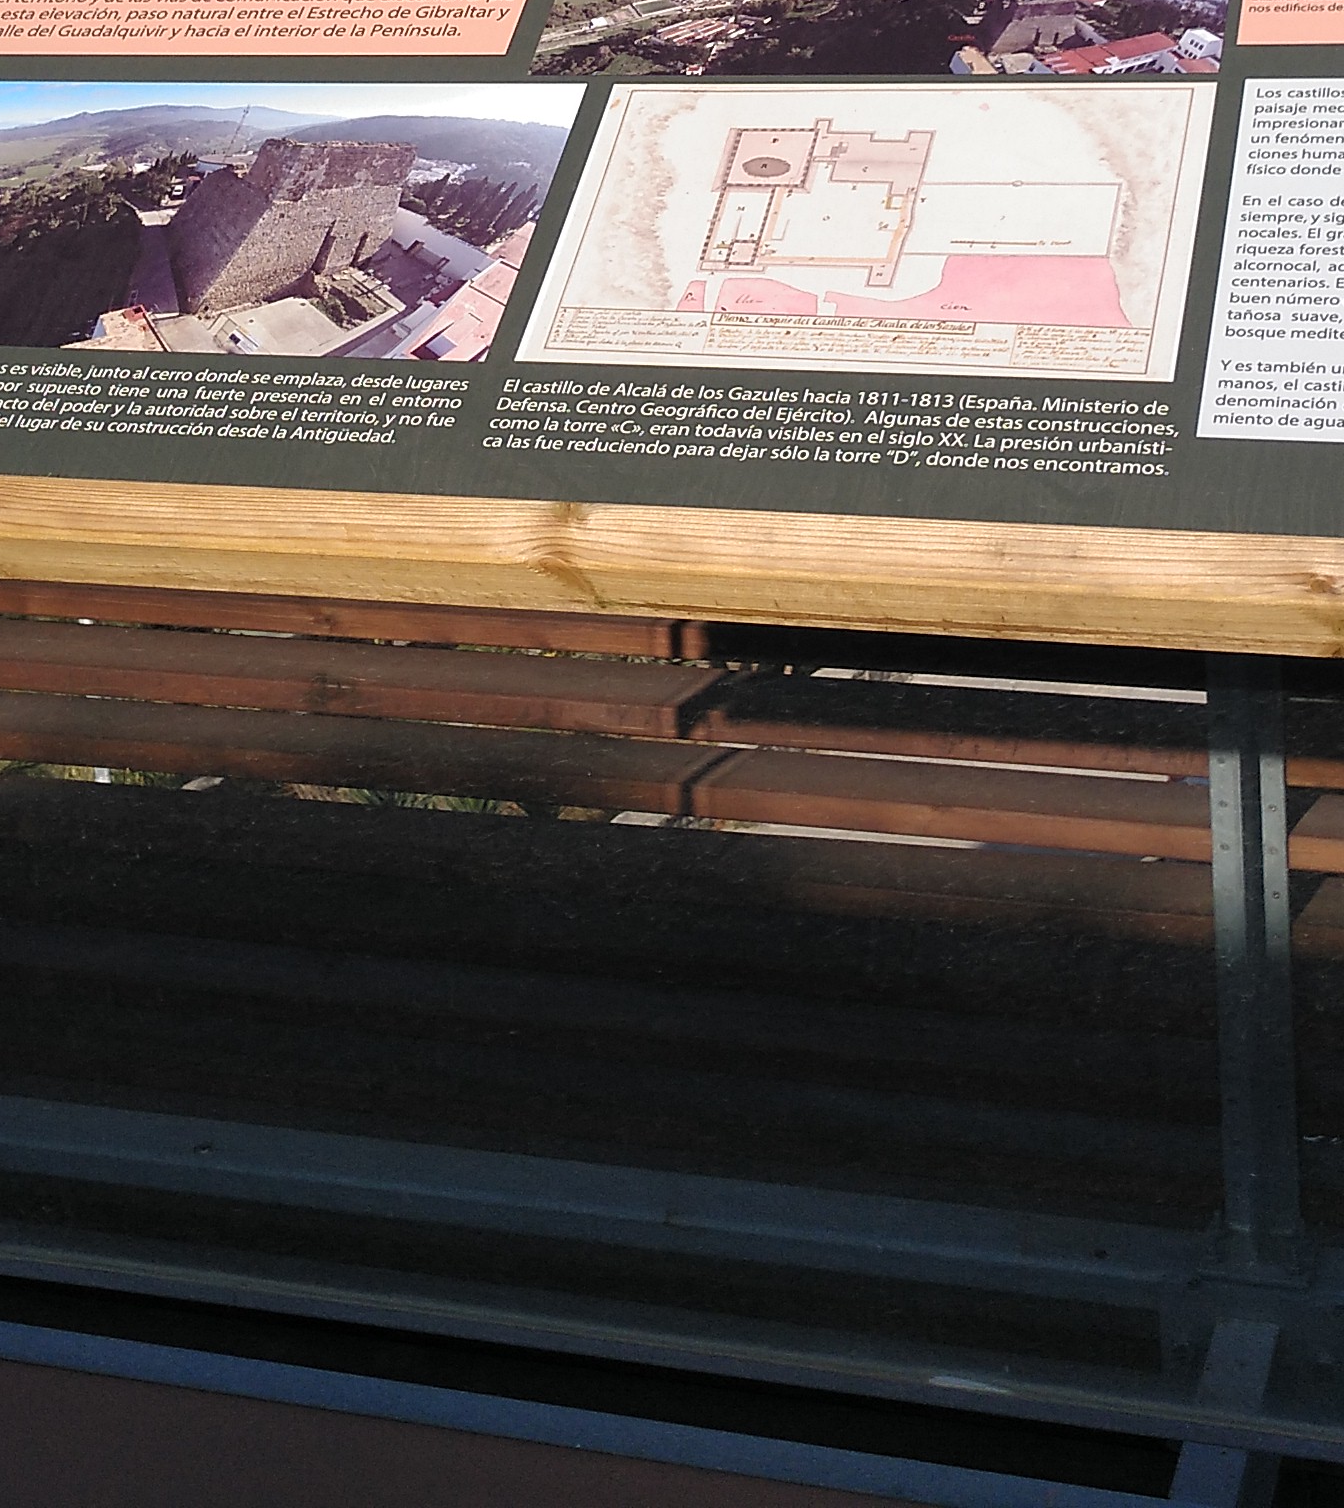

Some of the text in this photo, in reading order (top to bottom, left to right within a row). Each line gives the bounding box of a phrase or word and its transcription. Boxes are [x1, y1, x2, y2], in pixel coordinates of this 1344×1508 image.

[1248, 5, 1271, 13] nos
[1273, 3, 1325, 12] edificios
[27, 24, 57, 37] del
[58, 24, 168, 40] Guadalquivir
[168, 27, 182, 41] y
[184, 24, 230, 37] hacia
[234, 24, 253, 37] el
[253, 24, 321, 37] interior
[323, 24, 346, 37] de
[350, 23, 366, 37] la
[370, 23, 461, 37] Península.
[1256, 88, 1282, 98] Los
[1227, 309, 1281, 321] tañosa
[1291, 312, 1343, 324] suave,
[1225, 325, 1286, 340] bosque
[1213, 412, 1273, 425] miento
[1277, 414, 1299, 426] de
[14, 414, 59, 432] lugar
[60, 416, 82, 430] de
[83, 420, 105, 431] su
[107, 421, 214, 436] construcción
[217, 423, 269, 438] desde
[271, 424, 287, 439] la
[289, 426, 396, 444] Antigüedad.
[482, 434, 1169, 476] ca las fue reduciendo para dejar sólo la torre “D”, donde nos encontramos.
